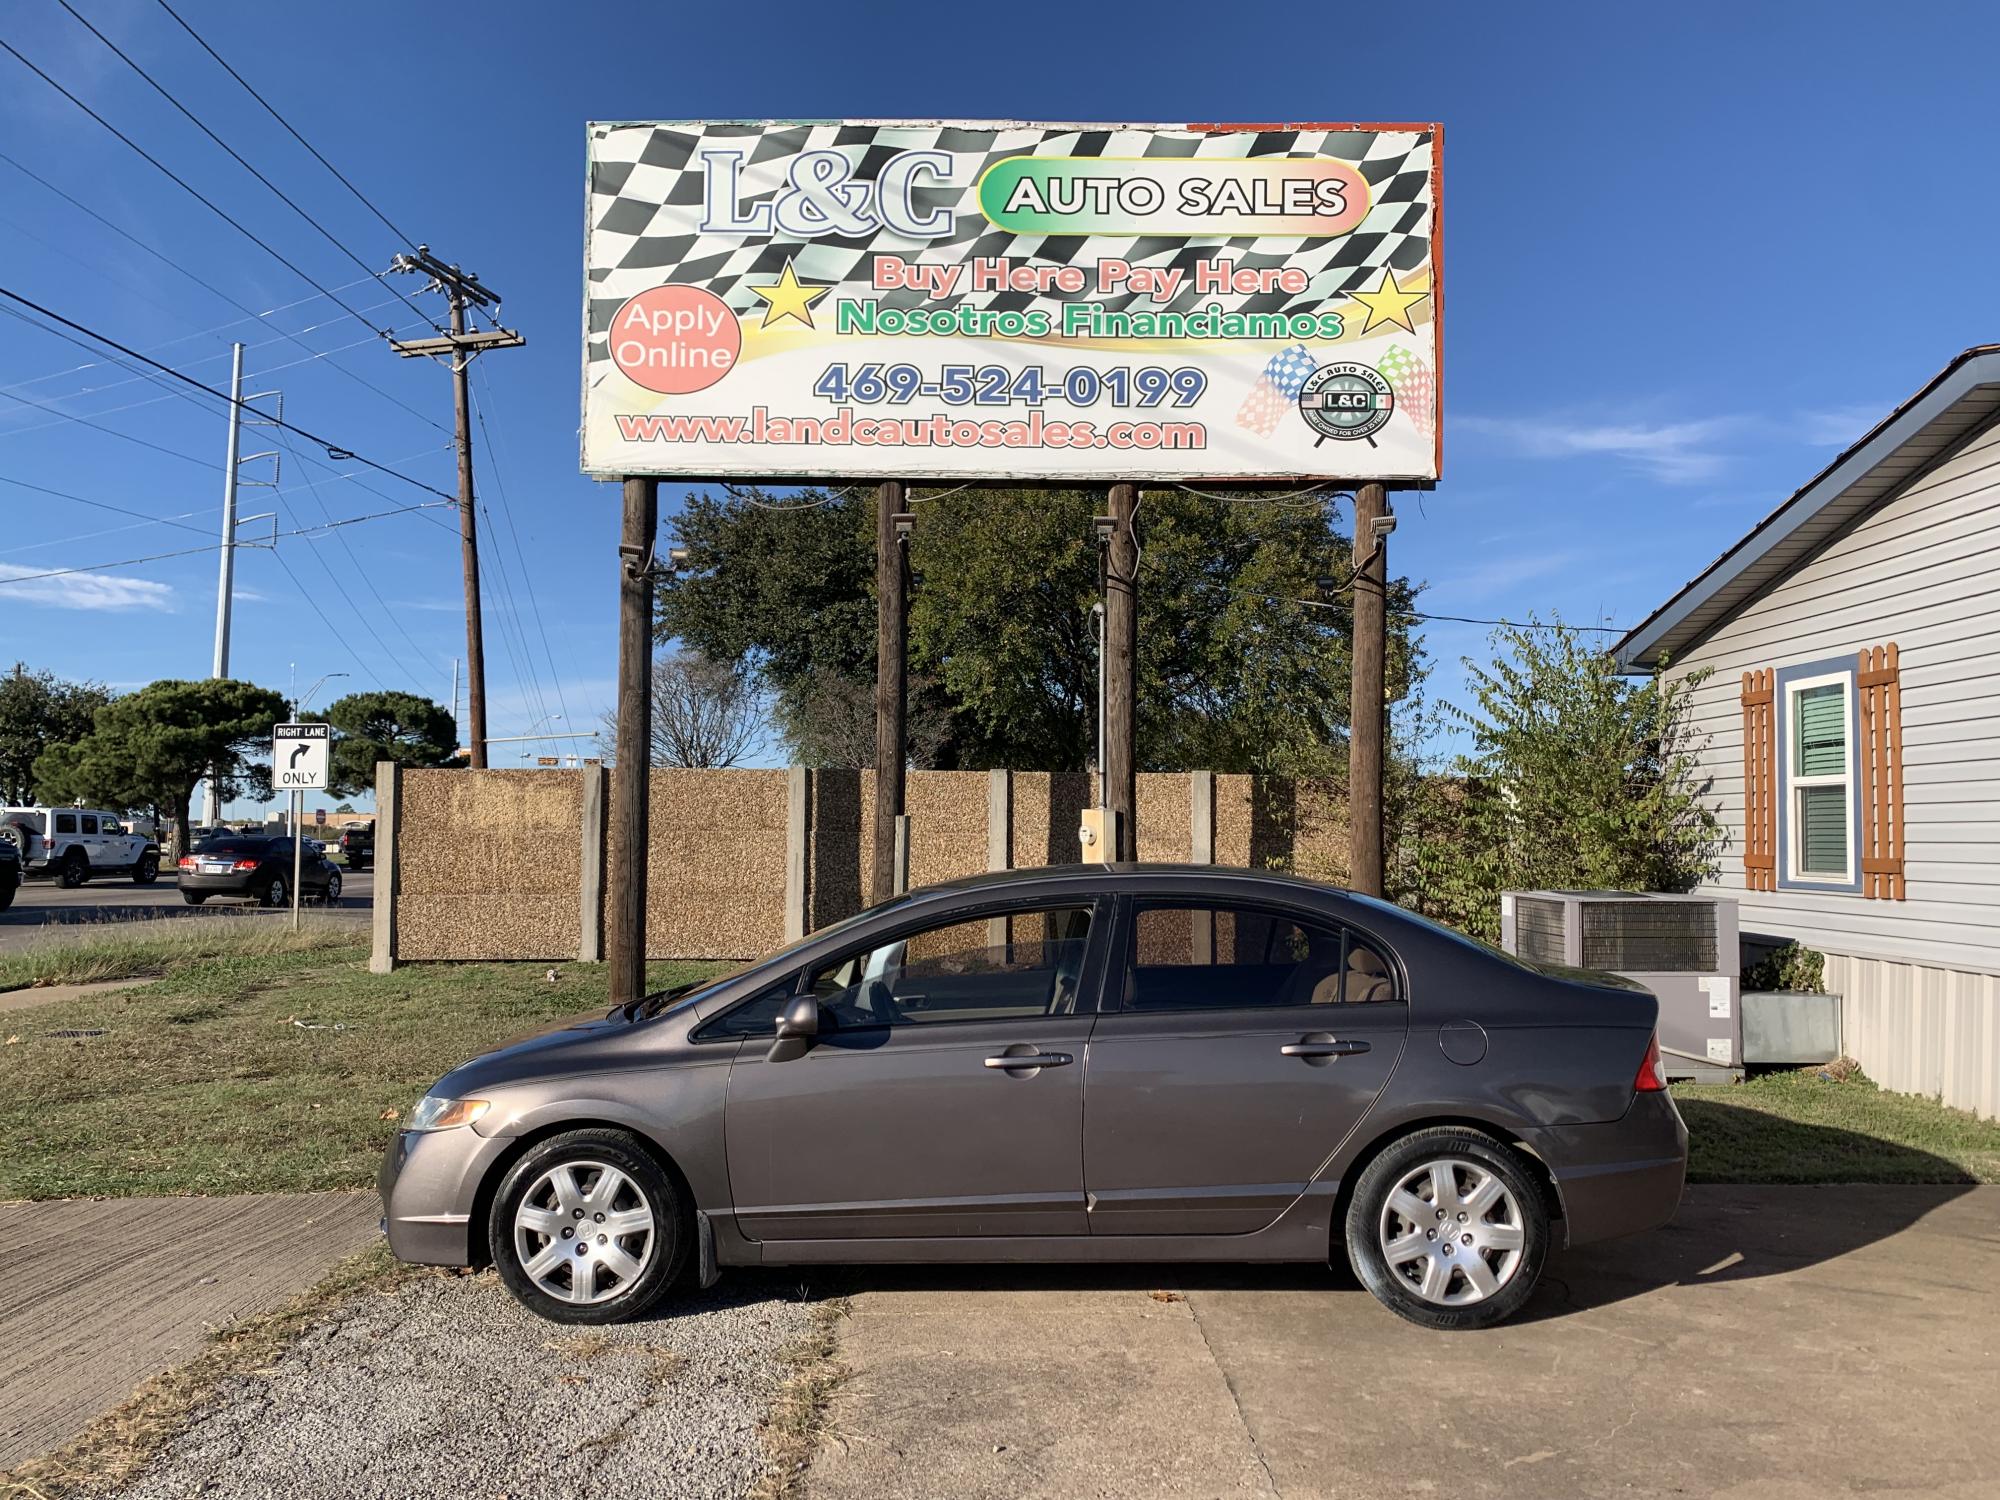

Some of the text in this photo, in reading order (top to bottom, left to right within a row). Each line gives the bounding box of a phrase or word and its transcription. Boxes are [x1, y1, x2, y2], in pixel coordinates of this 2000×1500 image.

[700, 150, 953, 237] L&C
[1002, 176, 1348, 217] AUTO SALES
[872, 255, 1308, 303] Buy Here Pay Here
[623, 303, 726, 337] Apply
[836, 299, 1344, 341] Nosotros Financiamos
[617, 340, 732, 368] Online
[813, 362, 1208, 408] 469-524-0199
[1307, 366, 1386, 392] L&C AUTO SALES
[1327, 394, 1366, 408] L&C
[615, 406, 1207, 449] www.landcautosales.com
[1352, 427, 1369, 435] OVER
[277, 728, 325, 736] RIGHT LANE
[283, 772, 316, 784] ONLY
